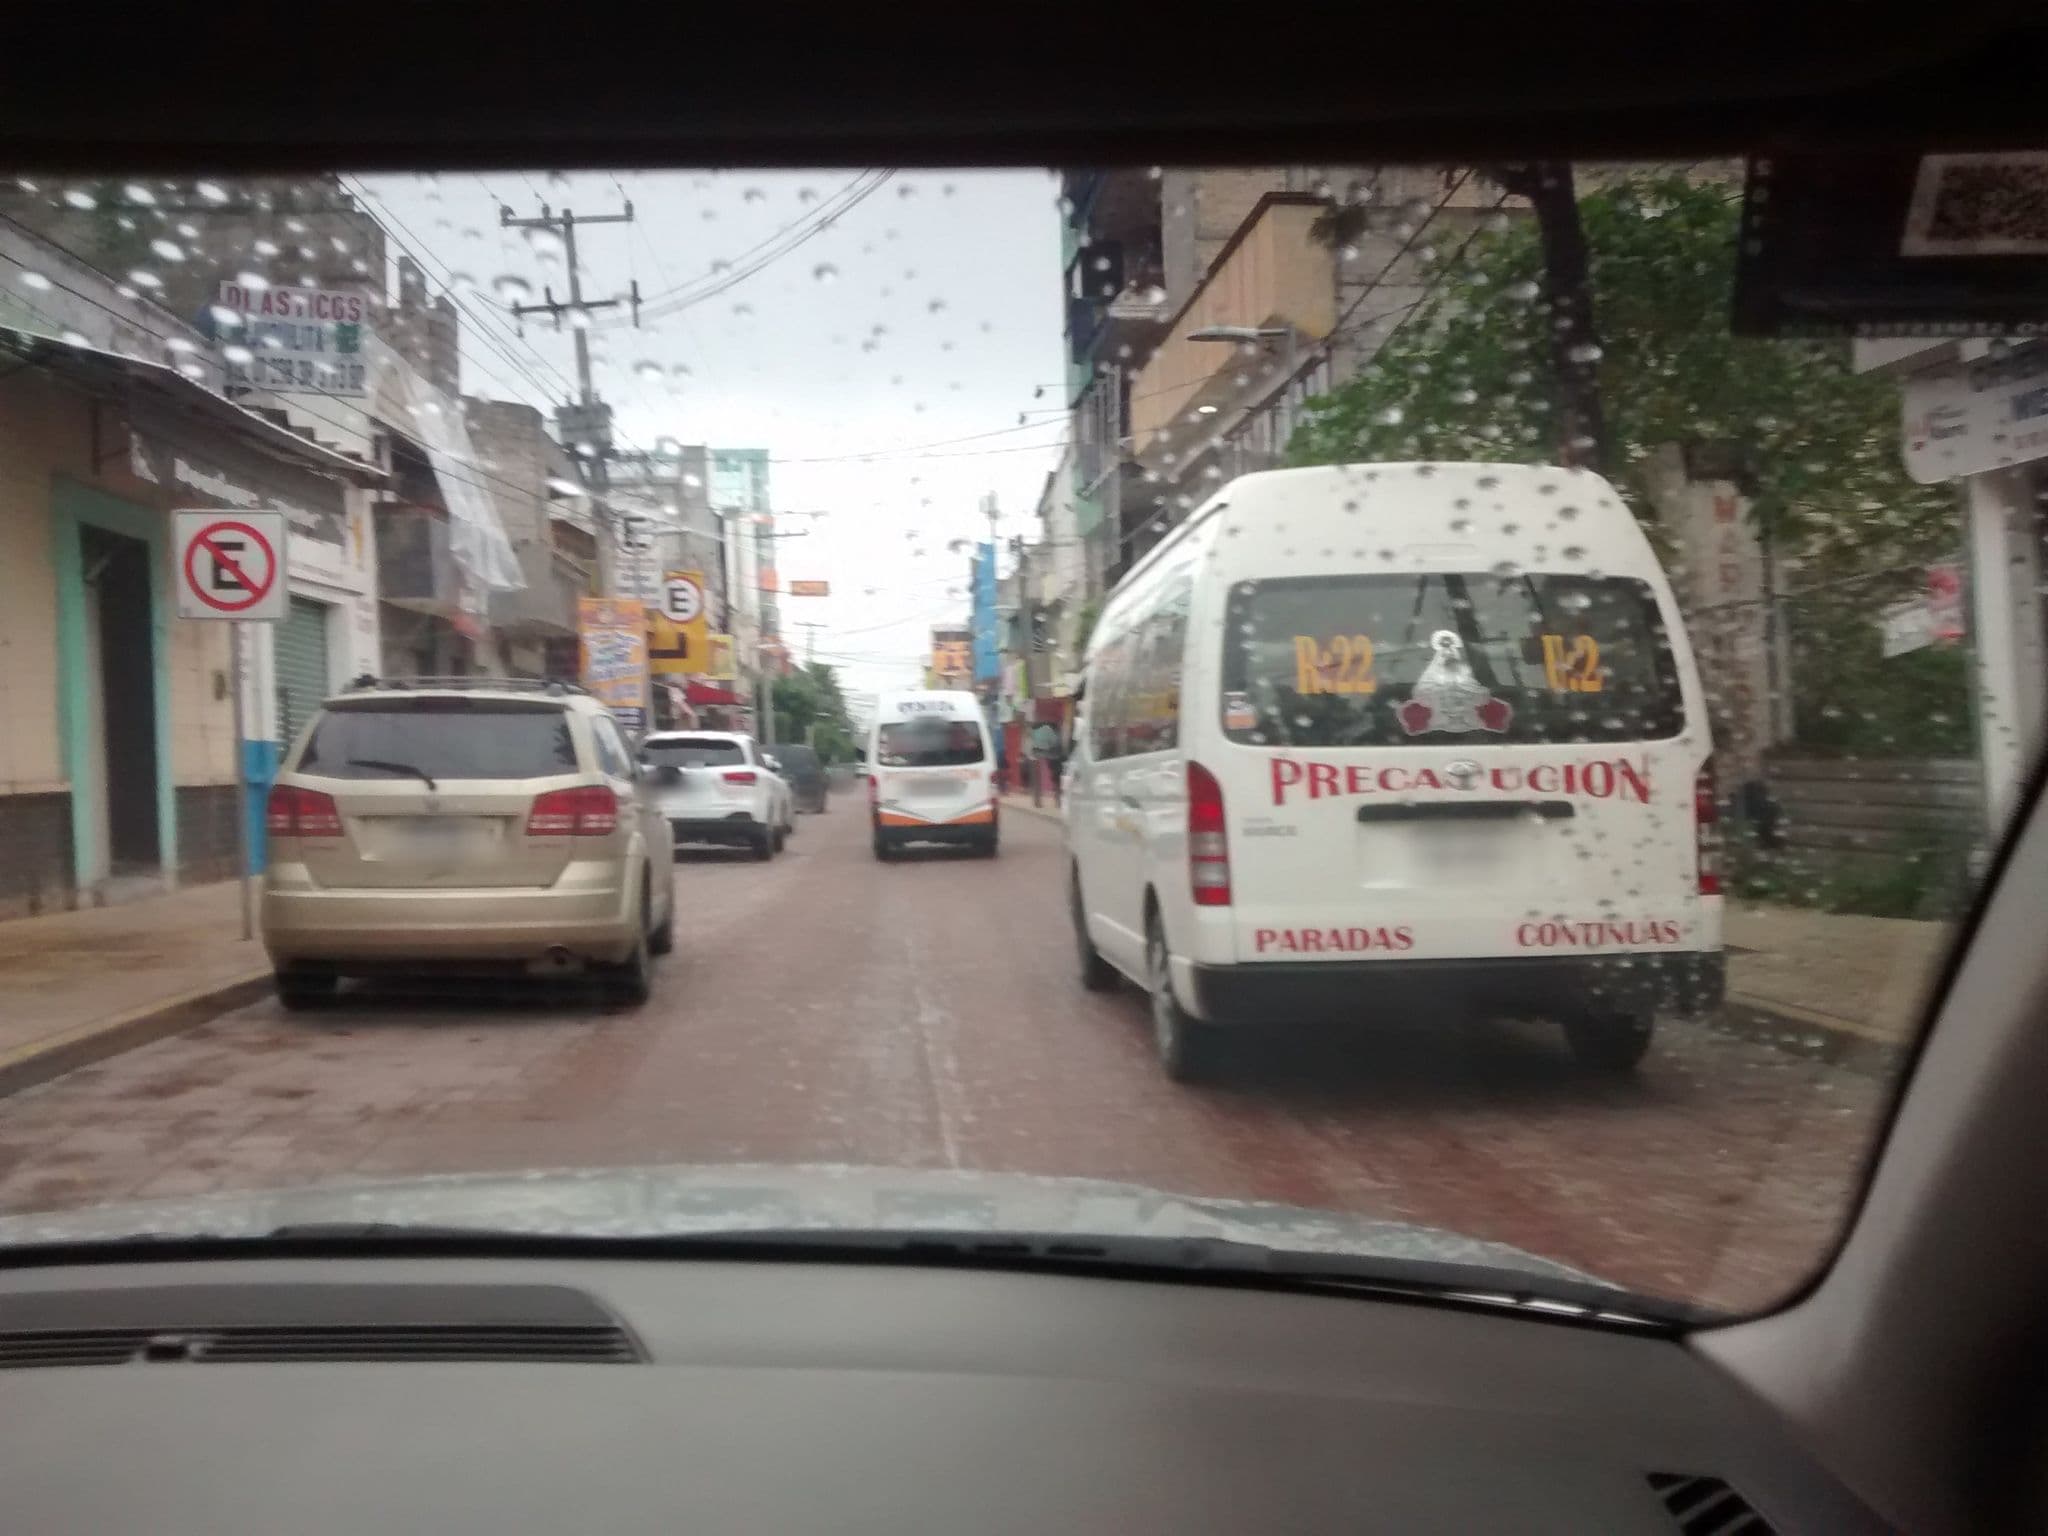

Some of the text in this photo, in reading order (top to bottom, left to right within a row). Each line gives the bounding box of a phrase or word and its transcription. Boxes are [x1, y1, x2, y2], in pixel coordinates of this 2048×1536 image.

[212, 541, 248, 590] E
[670, 587, 689, 613] E
[1255, 920, 1682, 953] PARADAS CONTINUAS
